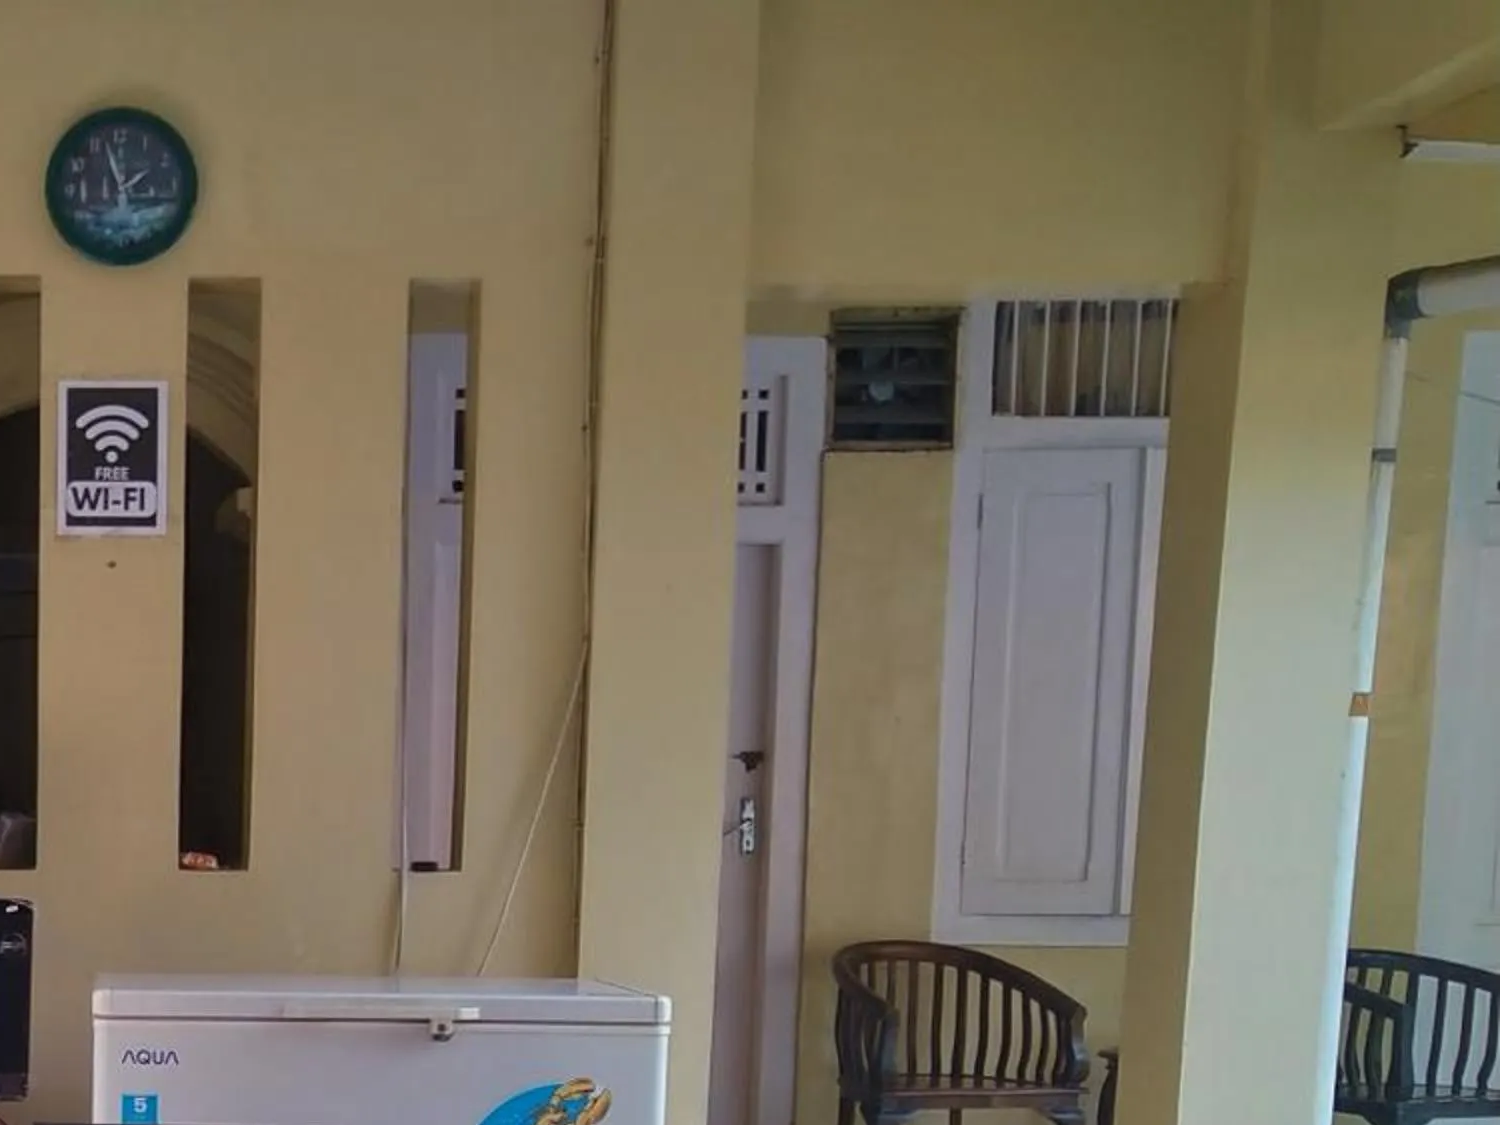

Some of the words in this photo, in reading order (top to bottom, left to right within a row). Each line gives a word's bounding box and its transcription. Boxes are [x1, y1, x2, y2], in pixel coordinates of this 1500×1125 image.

[95, 466, 130, 480] FREE
[71, 487, 146, 511] WI-FI
[121, 1049, 179, 1065] AQUA
[133, 1097, 148, 1113] 5
